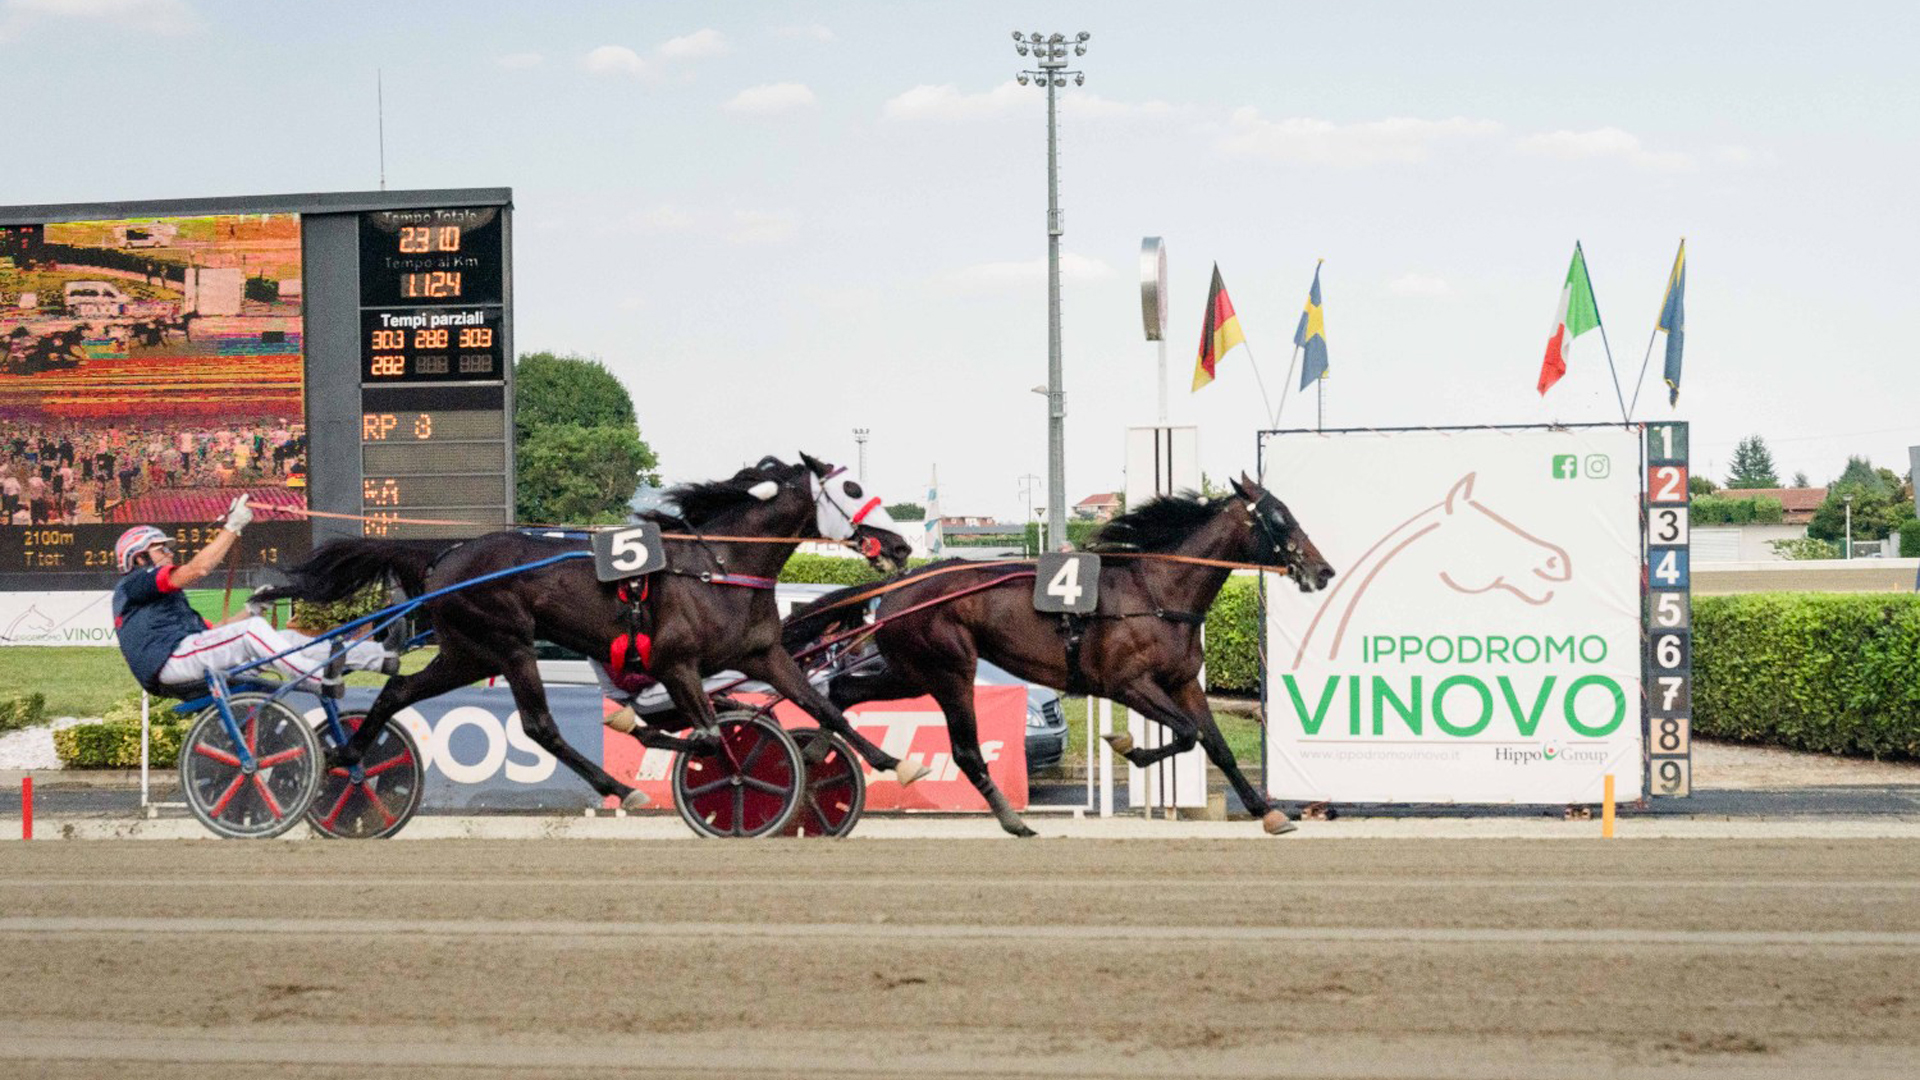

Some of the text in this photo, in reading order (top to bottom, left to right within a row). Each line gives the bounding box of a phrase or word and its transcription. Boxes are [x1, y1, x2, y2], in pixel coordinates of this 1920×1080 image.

[385, 257, 432, 271] Tempo
[453, 256, 479, 267] Km
[381, 311, 484, 329] Tempi parziali
[363, 414, 397, 440] RP
[1661, 426, 1673, 459] 1
[1656, 467, 1680, 500] 2
[24, 531, 74, 545] 2100m
[1658, 510, 1679, 541] 3
[611, 528, 649, 572] 5
[1047, 558, 1082, 605] 4
[1656, 551, 1680, 584] 4
[1657, 593, 1682, 627] 5
[63, 627, 118, 641] VINOV
[1363, 635, 1608, 664] IPPODROMO
[1657, 635, 1681, 668] 6
[1281, 674, 1626, 738] VINOVO
[1658, 677, 1683, 711] 7
[1659, 718, 1680, 751] 8
[1299, 749, 1461, 761] www.ippodromovinovo.it
[1495, 747, 1608, 765] Hippo Group
[1659, 761, 1681, 793] 9
